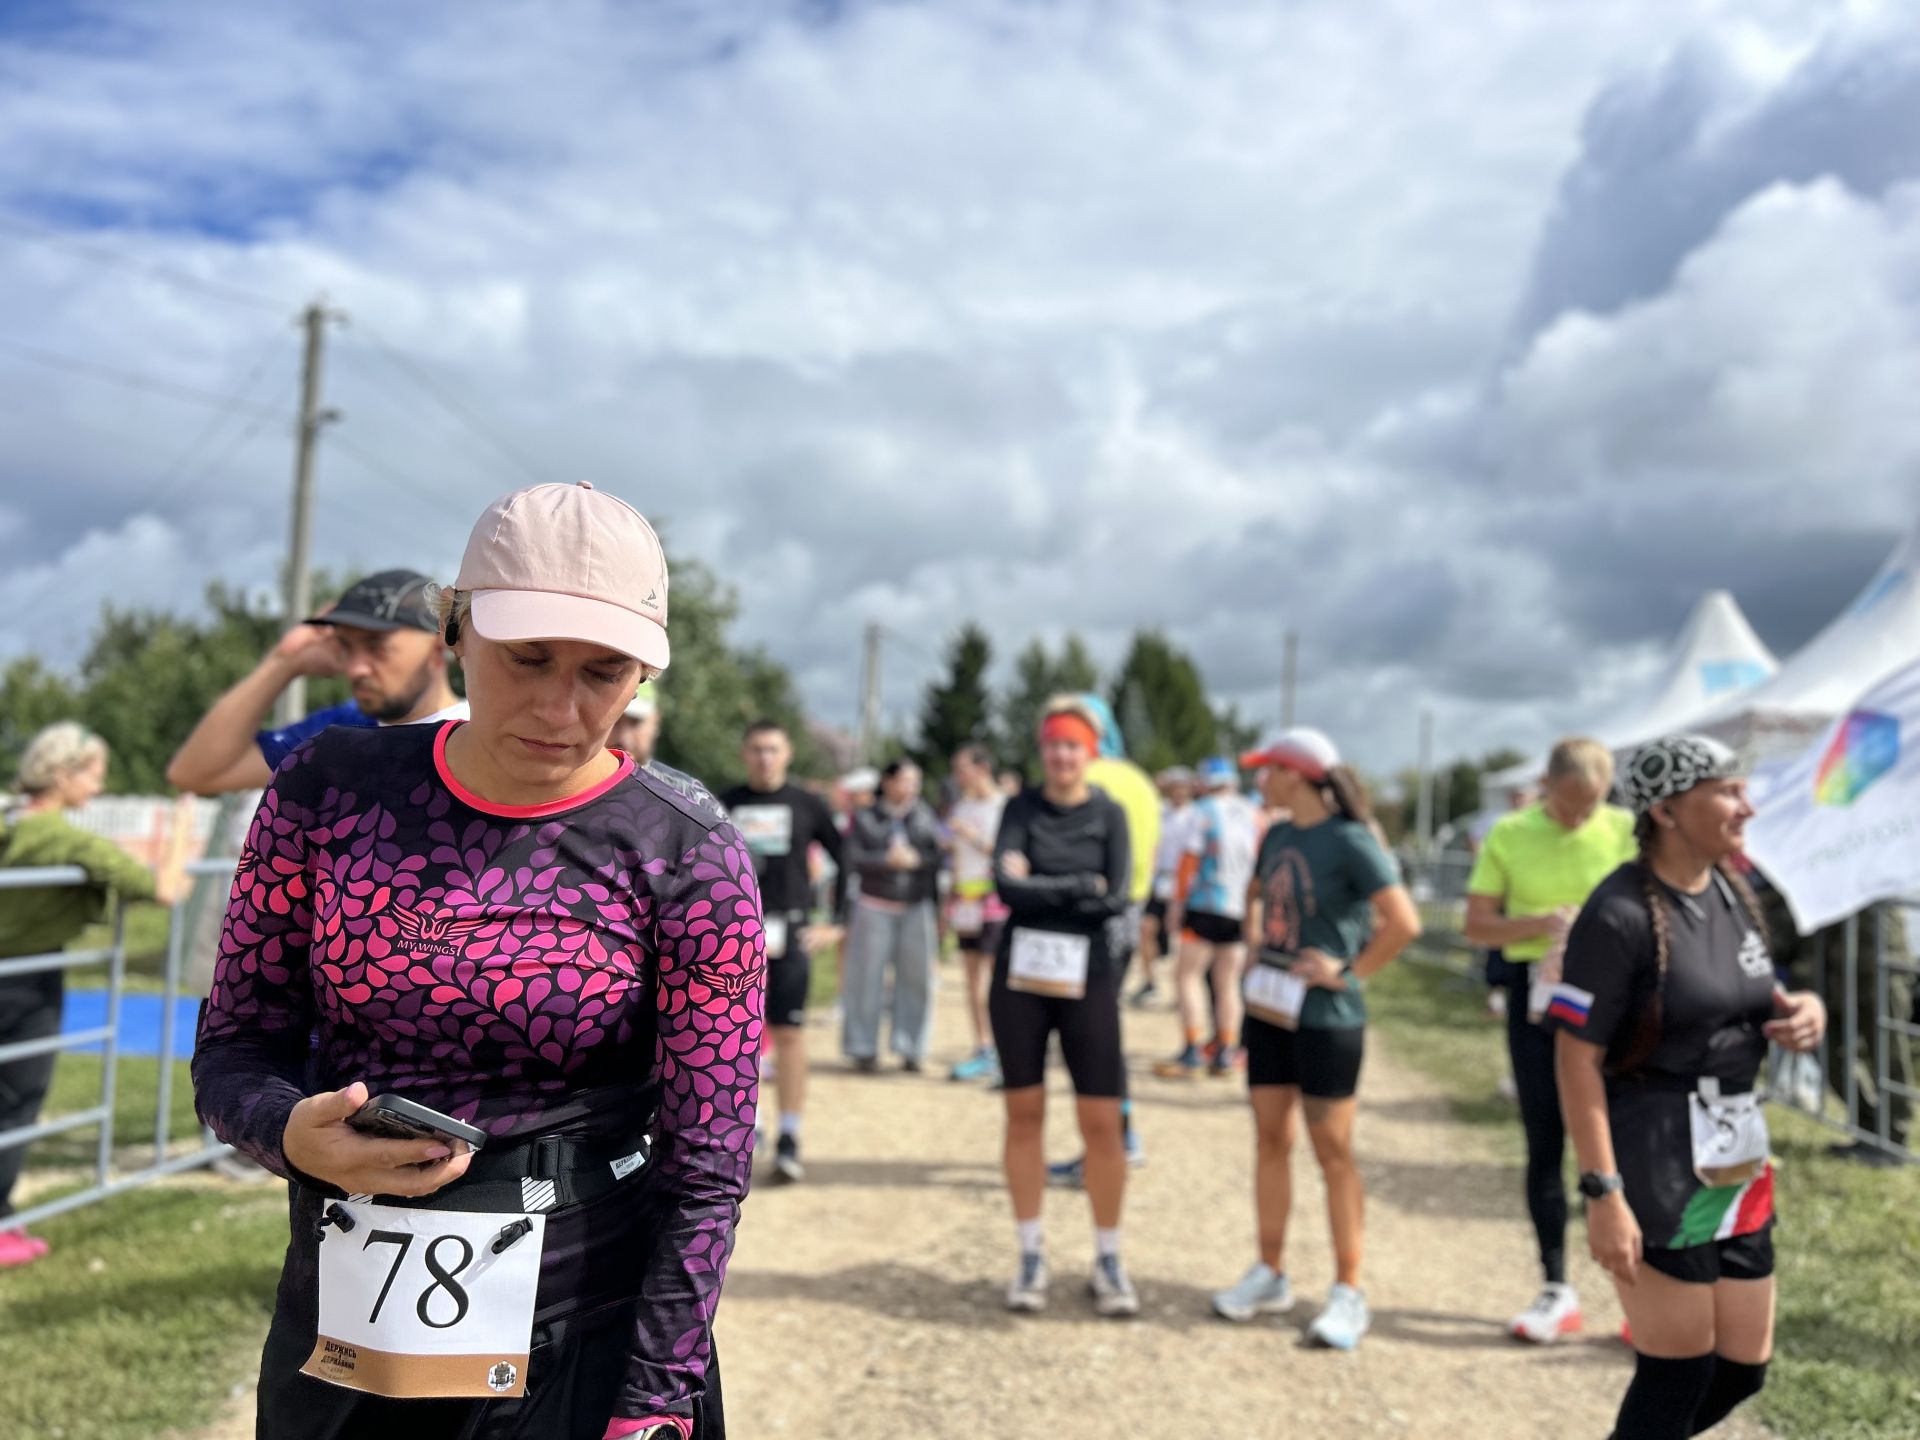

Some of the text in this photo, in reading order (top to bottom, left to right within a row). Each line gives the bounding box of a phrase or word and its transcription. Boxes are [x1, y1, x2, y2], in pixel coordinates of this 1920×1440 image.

[397, 940, 456, 955] MY WINGS
[362, 1229, 474, 1329] 78
[324, 1341, 357, 1359] ДЕРЖИСЬ
